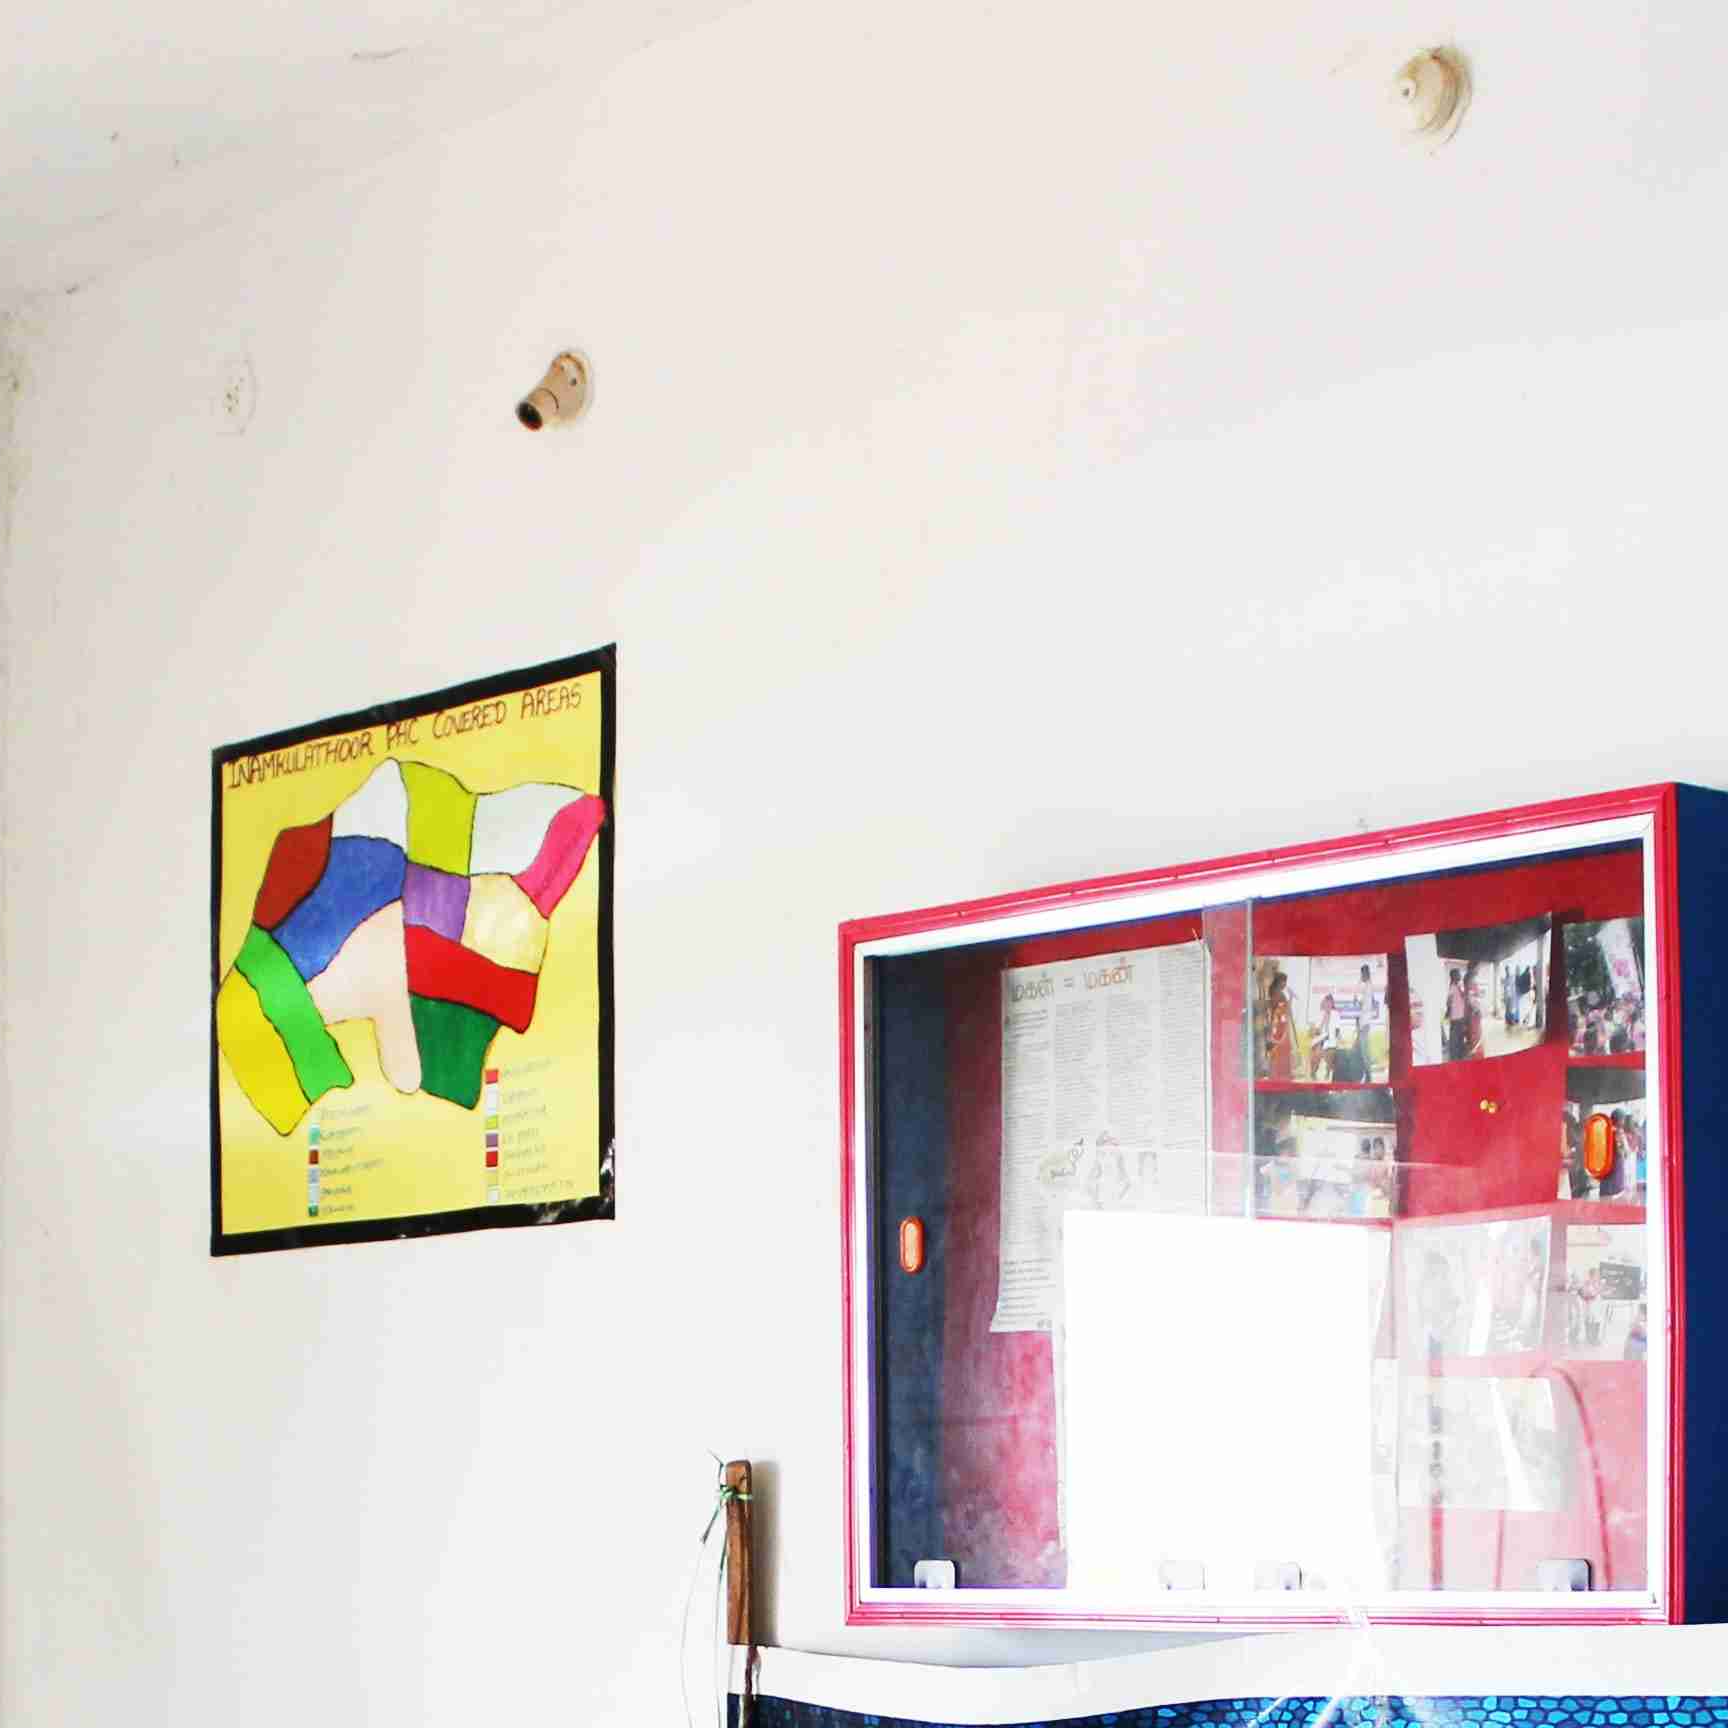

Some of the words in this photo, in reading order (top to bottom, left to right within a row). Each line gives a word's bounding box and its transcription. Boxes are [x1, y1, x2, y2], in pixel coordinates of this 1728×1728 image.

[384, 722, 419, 750] PHC
[431, 699, 508, 739] COVERED
[520, 682, 583, 720] AREAS
